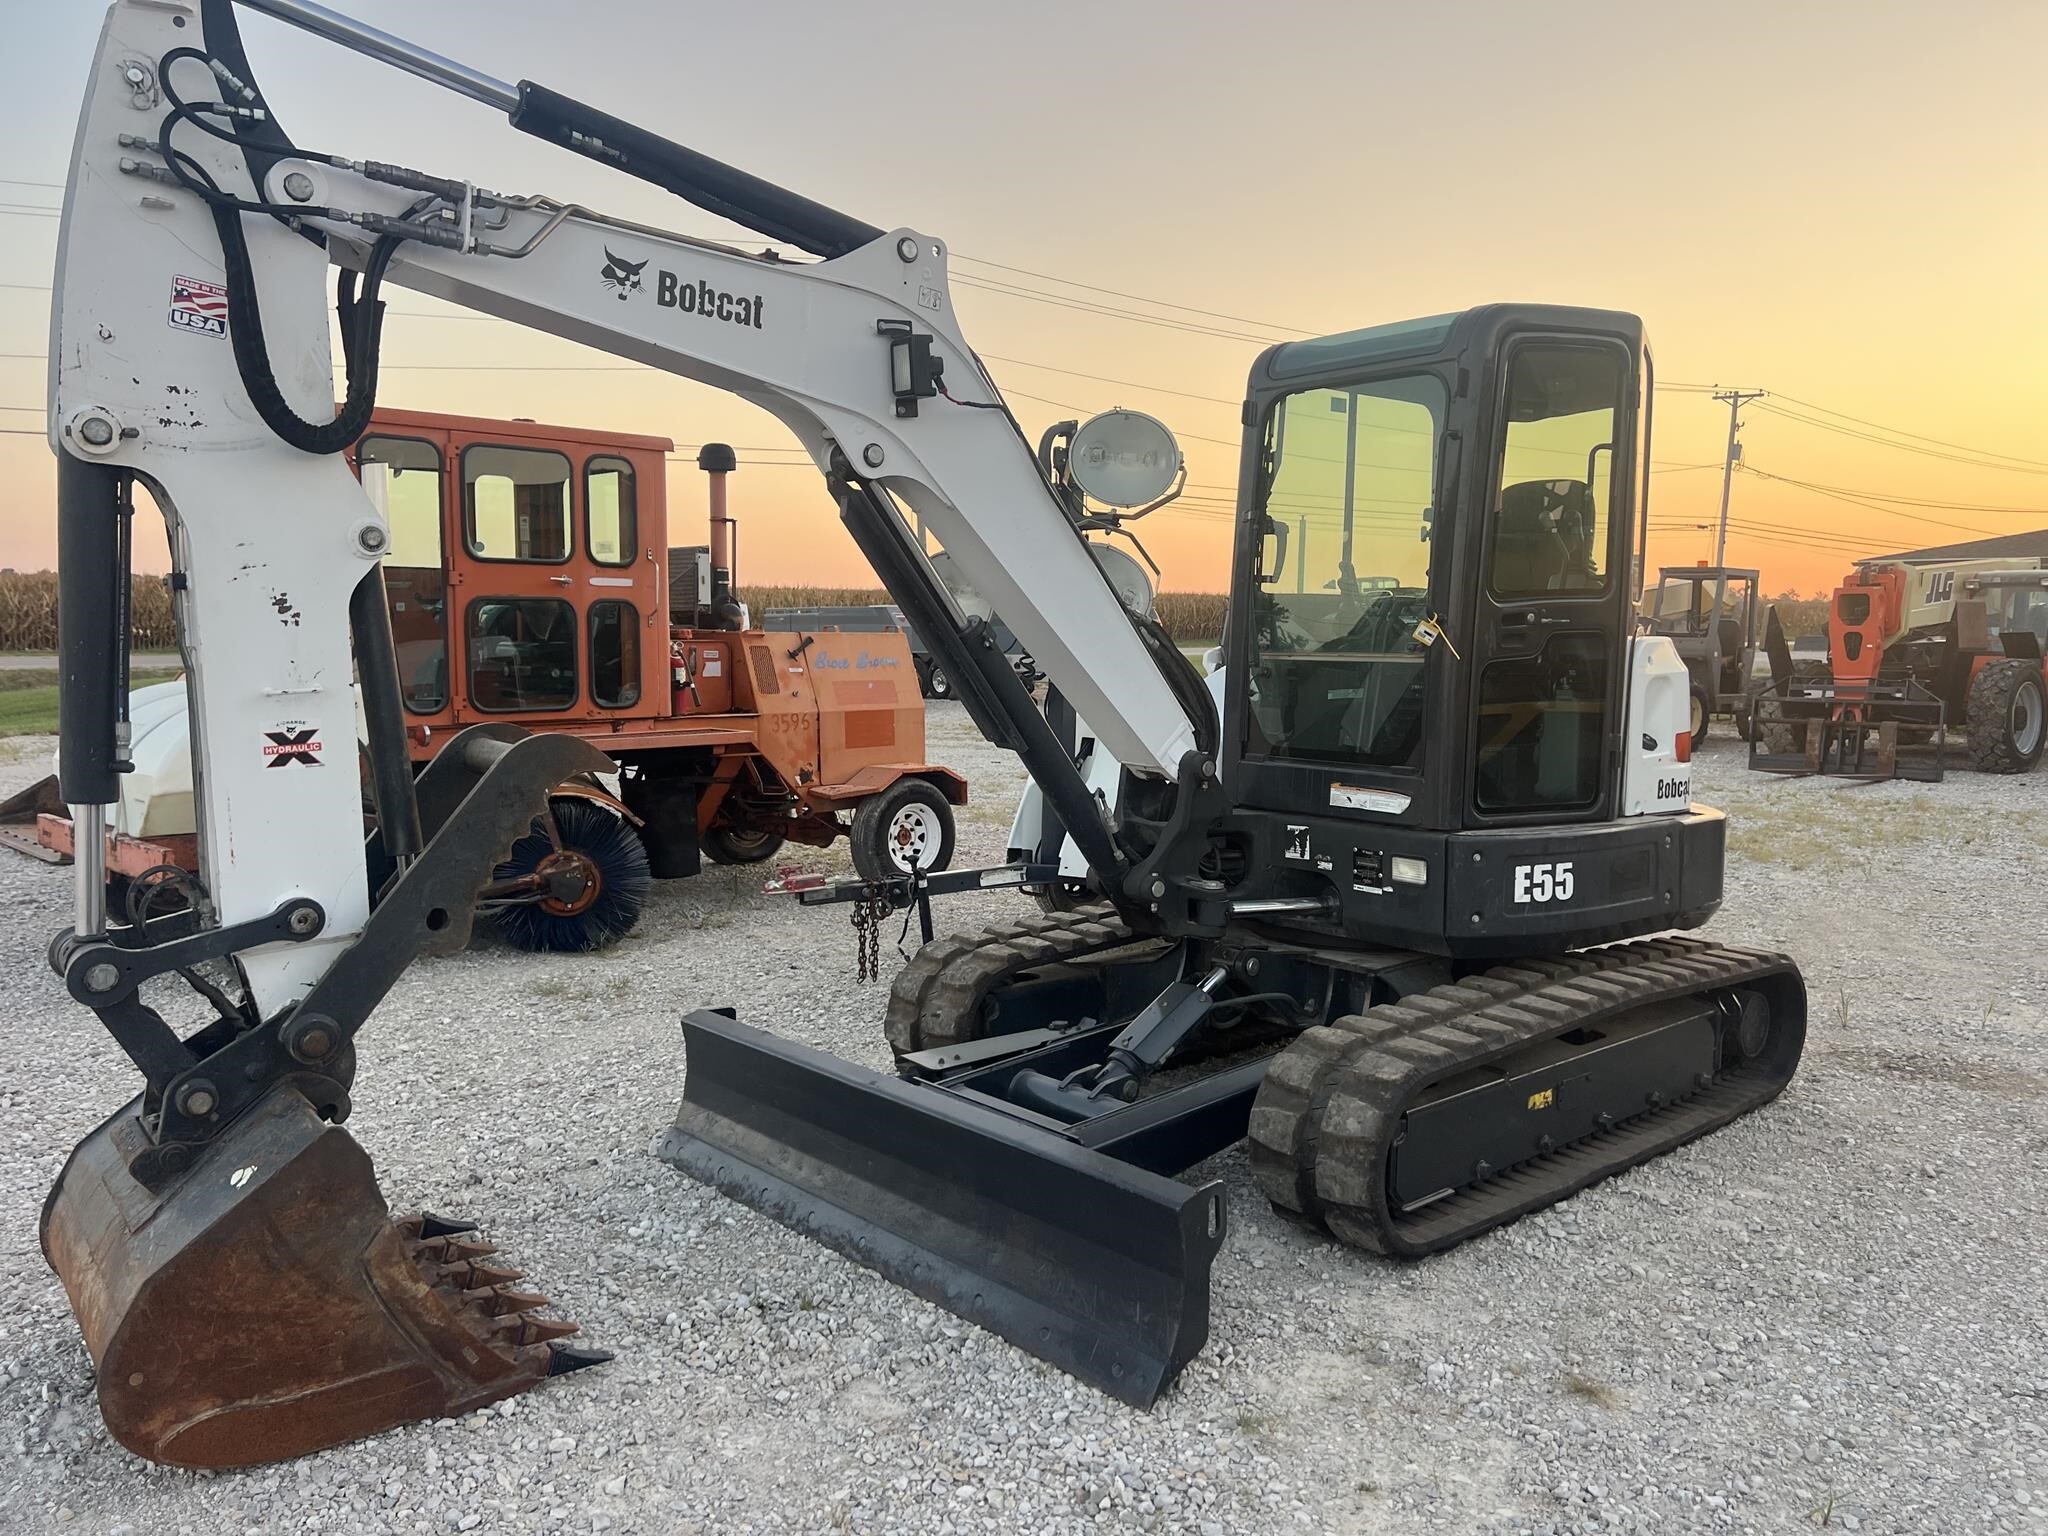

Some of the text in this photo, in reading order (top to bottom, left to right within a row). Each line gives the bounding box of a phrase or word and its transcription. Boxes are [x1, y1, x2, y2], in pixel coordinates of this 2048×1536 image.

[177, 279, 226, 296] MADE IN THE
[657, 270, 763, 329] Bobcat
[173, 310, 222, 333] USA
[1925, 571, 1955, 605] JLG
[772, 712, 811, 733] 3596
[265, 743, 320, 754] HYDRAULIC
[1514, 862, 1574, 904] E55
